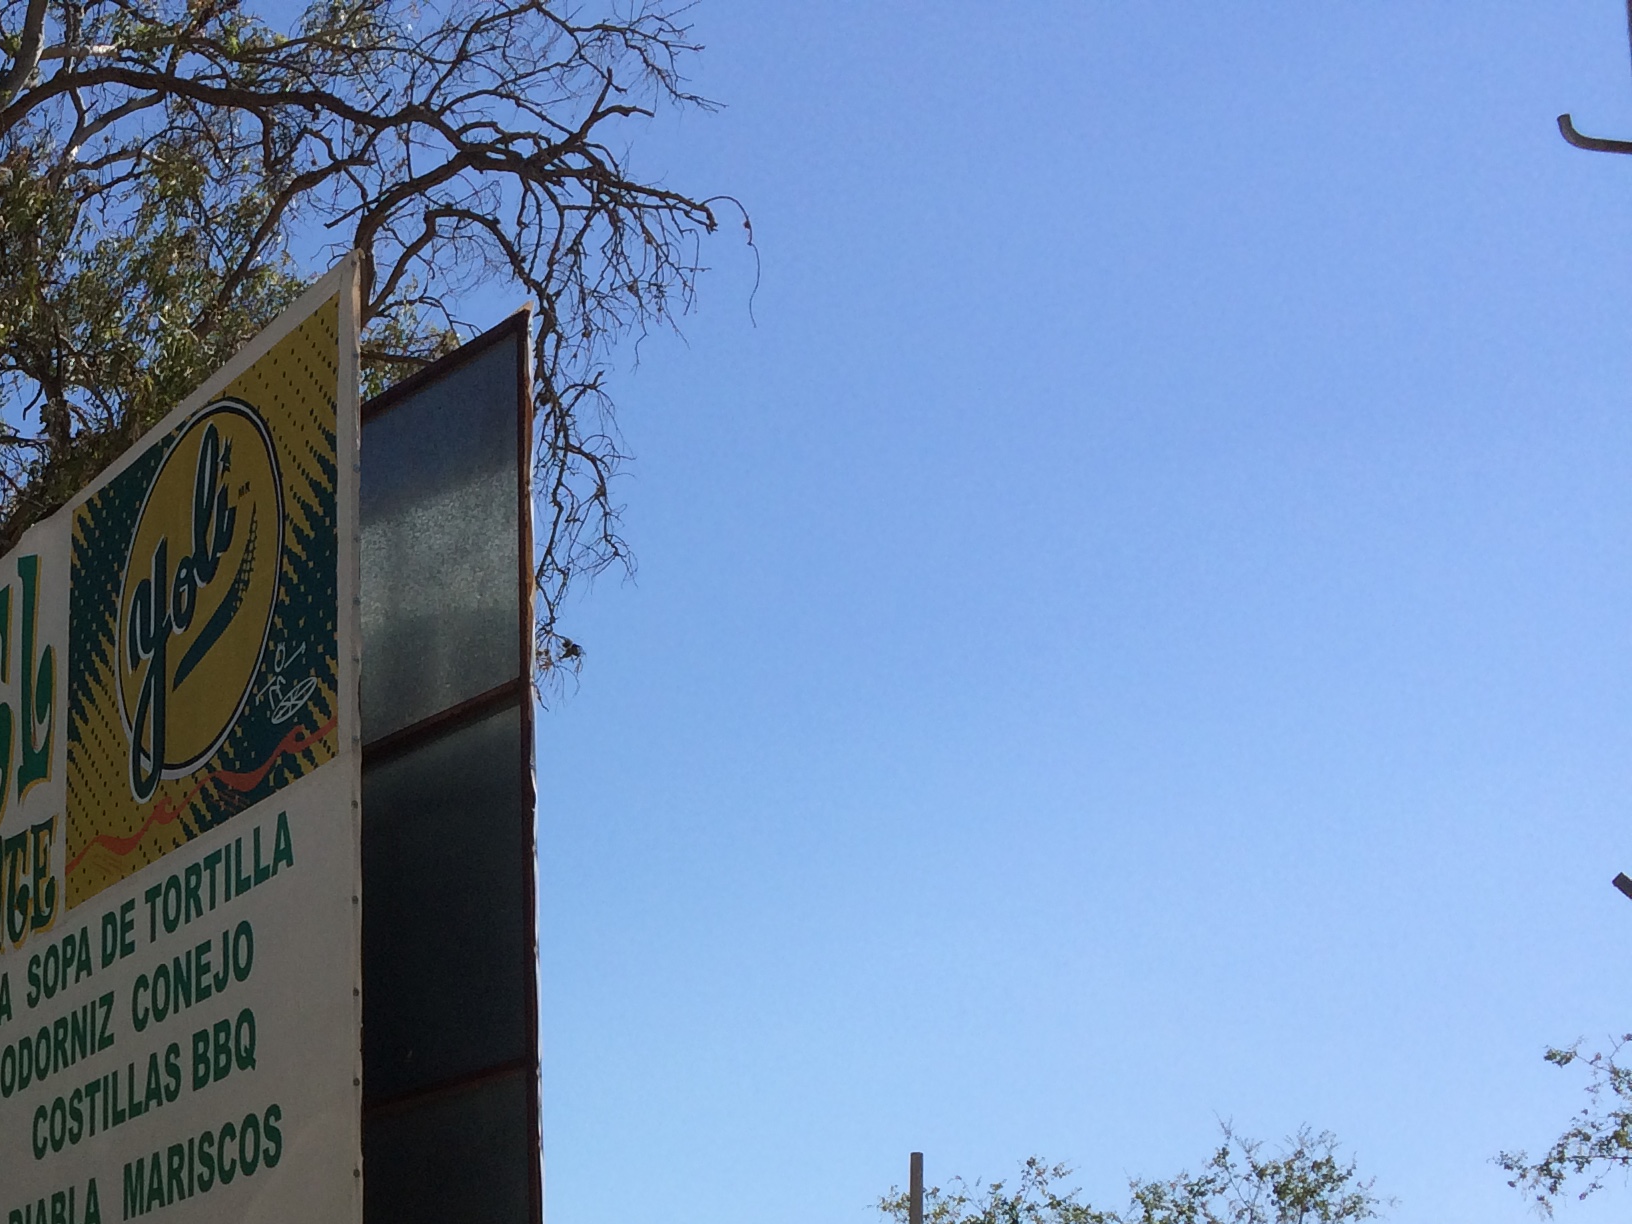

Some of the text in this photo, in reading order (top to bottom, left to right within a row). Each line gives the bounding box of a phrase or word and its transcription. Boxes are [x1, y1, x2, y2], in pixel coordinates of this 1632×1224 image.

[26, 933, 92, 1009] SOPA
[101, 911, 135, 970] DE
[145, 811, 294, 942] TORTILLA
[132, 920, 254, 1033] CONEJO
[32, 1007, 257, 1161] COSTILLAS BBQ
[122, 1103, 282, 1221] MARISCOS
